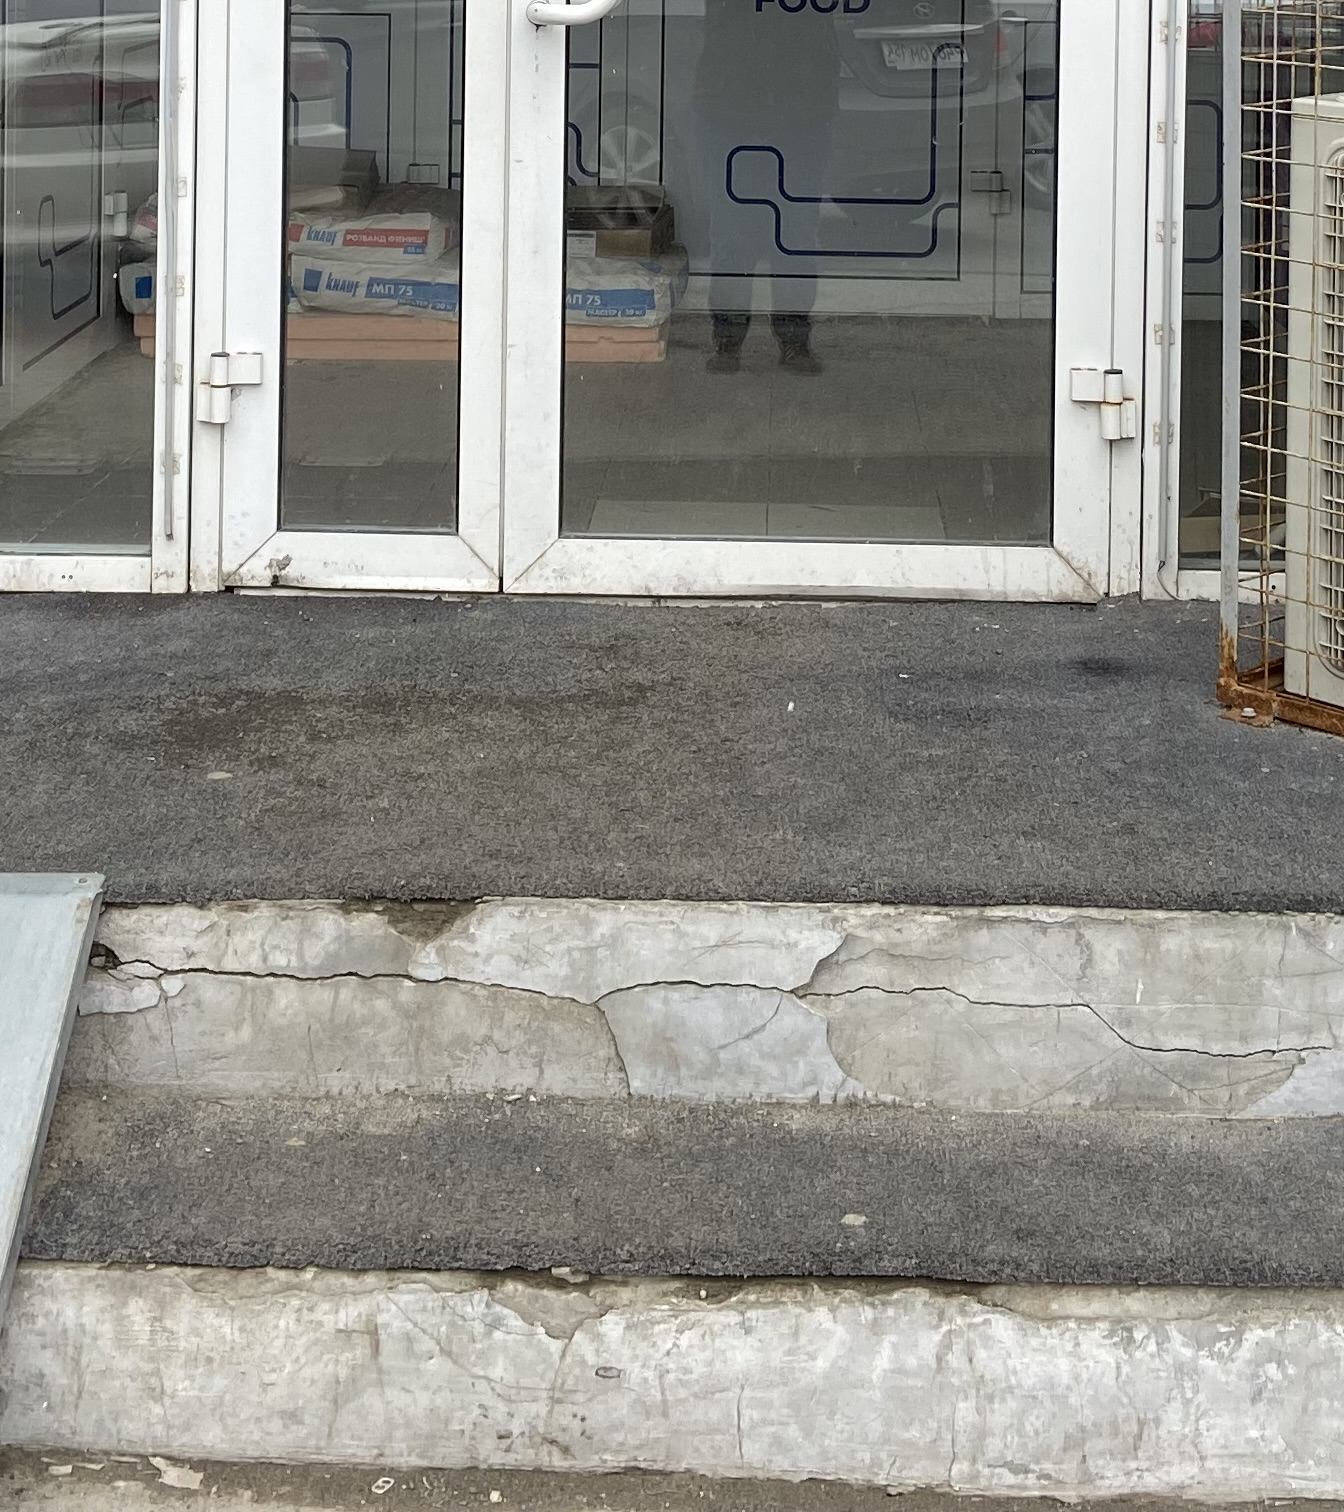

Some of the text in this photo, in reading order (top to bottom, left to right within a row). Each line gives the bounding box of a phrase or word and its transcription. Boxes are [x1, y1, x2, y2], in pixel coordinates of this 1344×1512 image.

[372, 282, 414, 296] МП 75
[586, 294, 601, 306] 75
